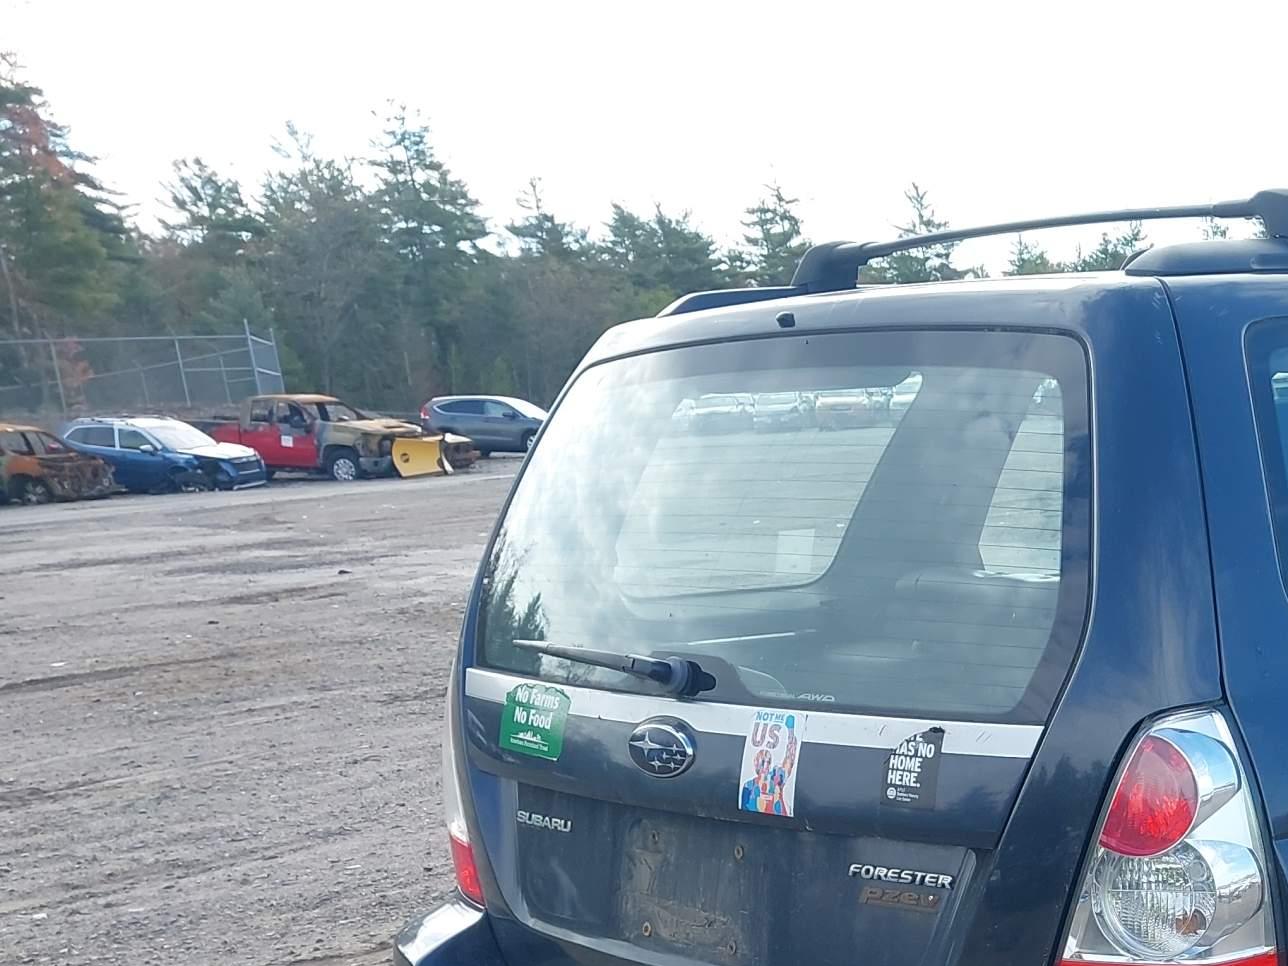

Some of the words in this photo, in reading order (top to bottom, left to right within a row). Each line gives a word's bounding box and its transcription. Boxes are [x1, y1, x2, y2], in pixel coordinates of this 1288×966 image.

[515, 686, 529, 704] No
[530, 688, 560, 710] Farms
[797, 693, 836, 702] AWD
[513, 706, 527, 725] No
[528, 708, 553, 730] Food
[756, 711, 774, 721] NOT
[751, 721, 782, 750] US
[917, 742, 935, 759] NO
[889, 754, 923, 772] HOME
[887, 769, 921, 788] HERE.
[516, 810, 572, 832] SUBARU
[847, 863, 953, 889] FORESTER
